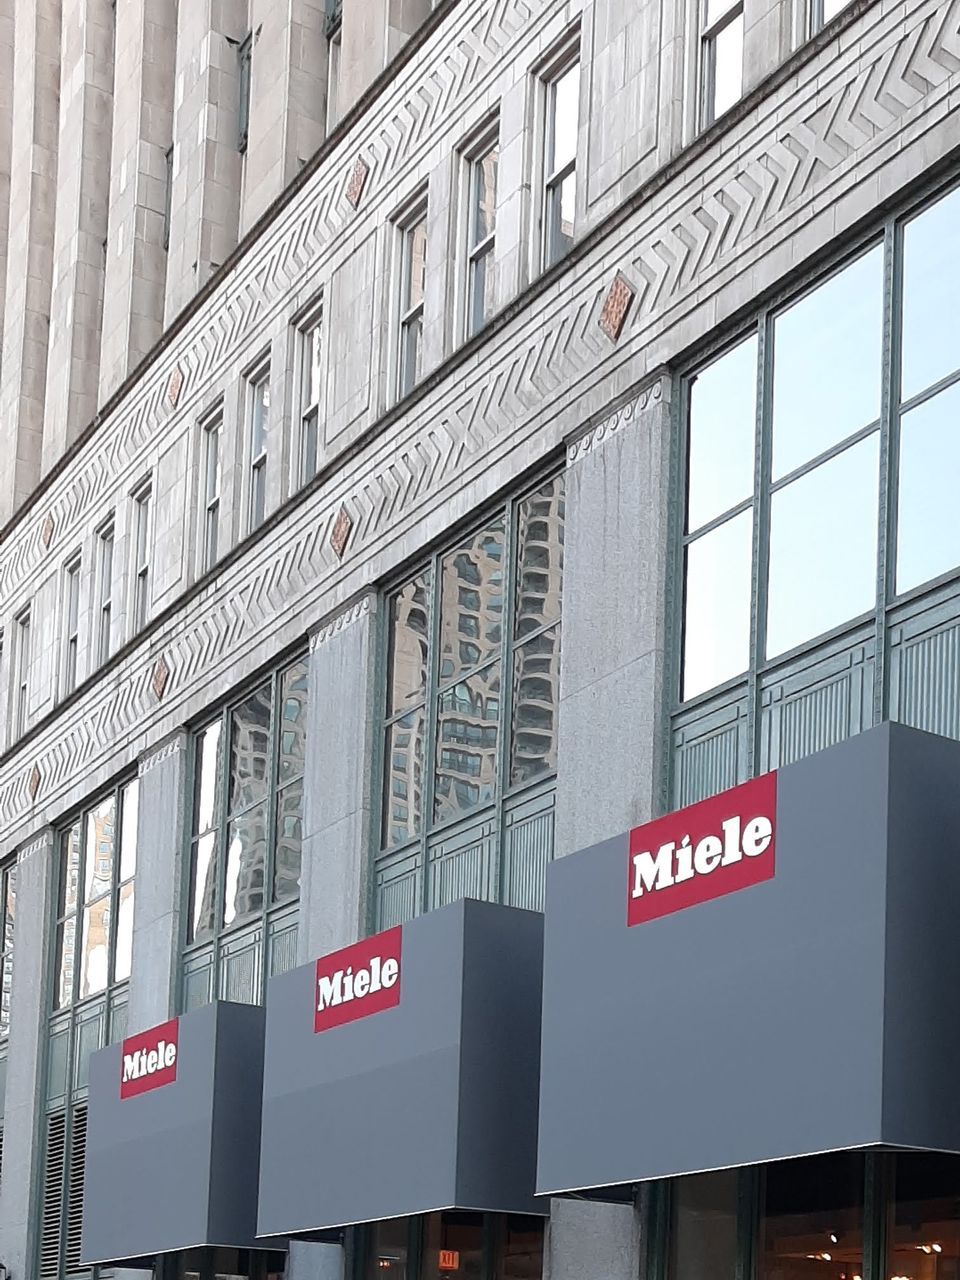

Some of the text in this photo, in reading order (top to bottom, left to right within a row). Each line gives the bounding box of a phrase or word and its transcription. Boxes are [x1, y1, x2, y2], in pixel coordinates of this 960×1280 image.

[632, 815, 773, 899] Miele
[317, 956, 399, 1012] Miele
[123, 1040, 176, 1083] Miele
